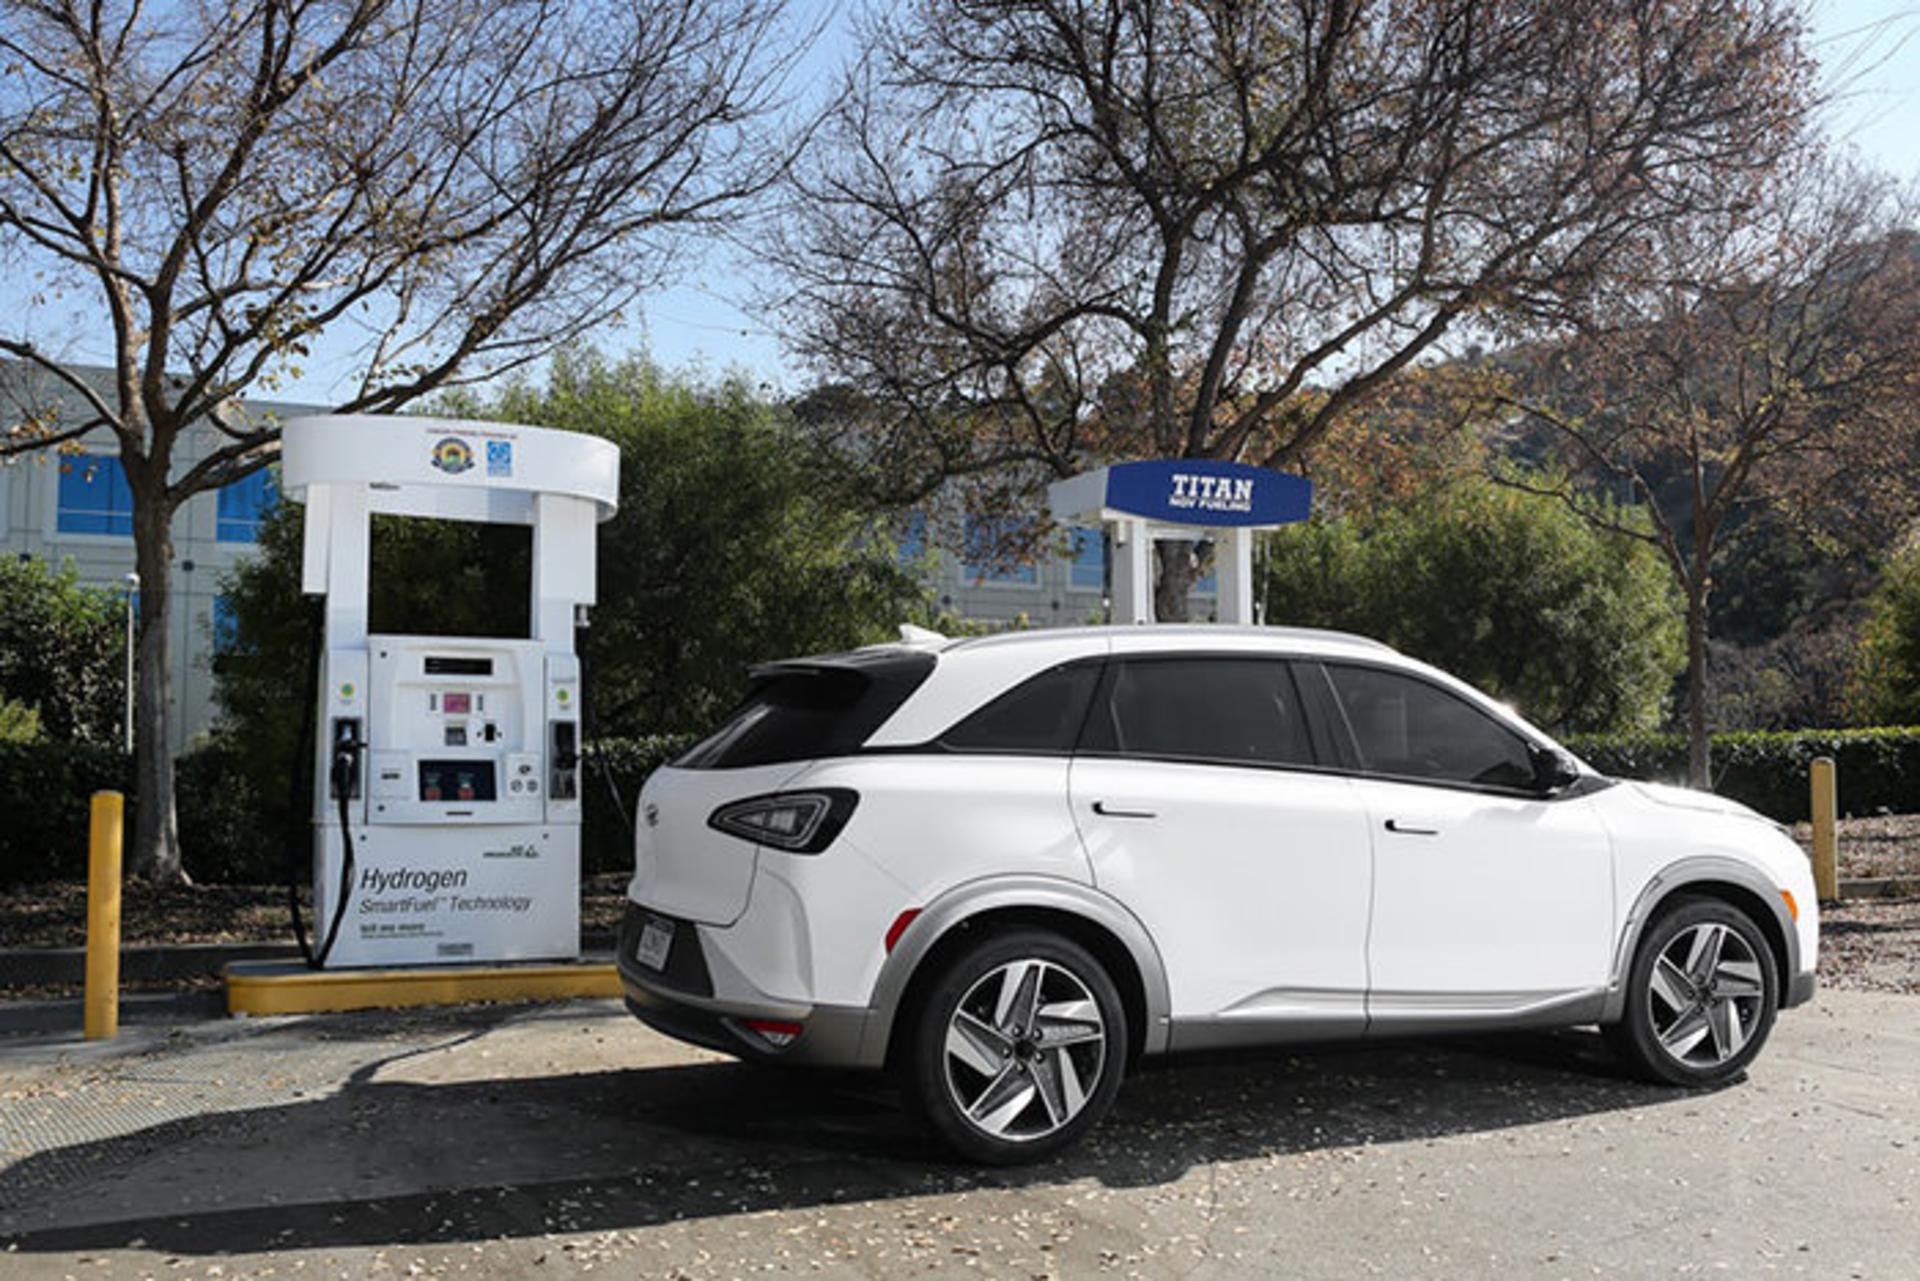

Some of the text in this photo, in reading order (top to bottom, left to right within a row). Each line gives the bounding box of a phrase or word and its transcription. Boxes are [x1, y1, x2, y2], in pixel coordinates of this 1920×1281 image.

[1172, 474, 1254, 500] TITAN
[361, 867, 467, 894] Hydrogen
[449, 896, 532, 911] Technology
